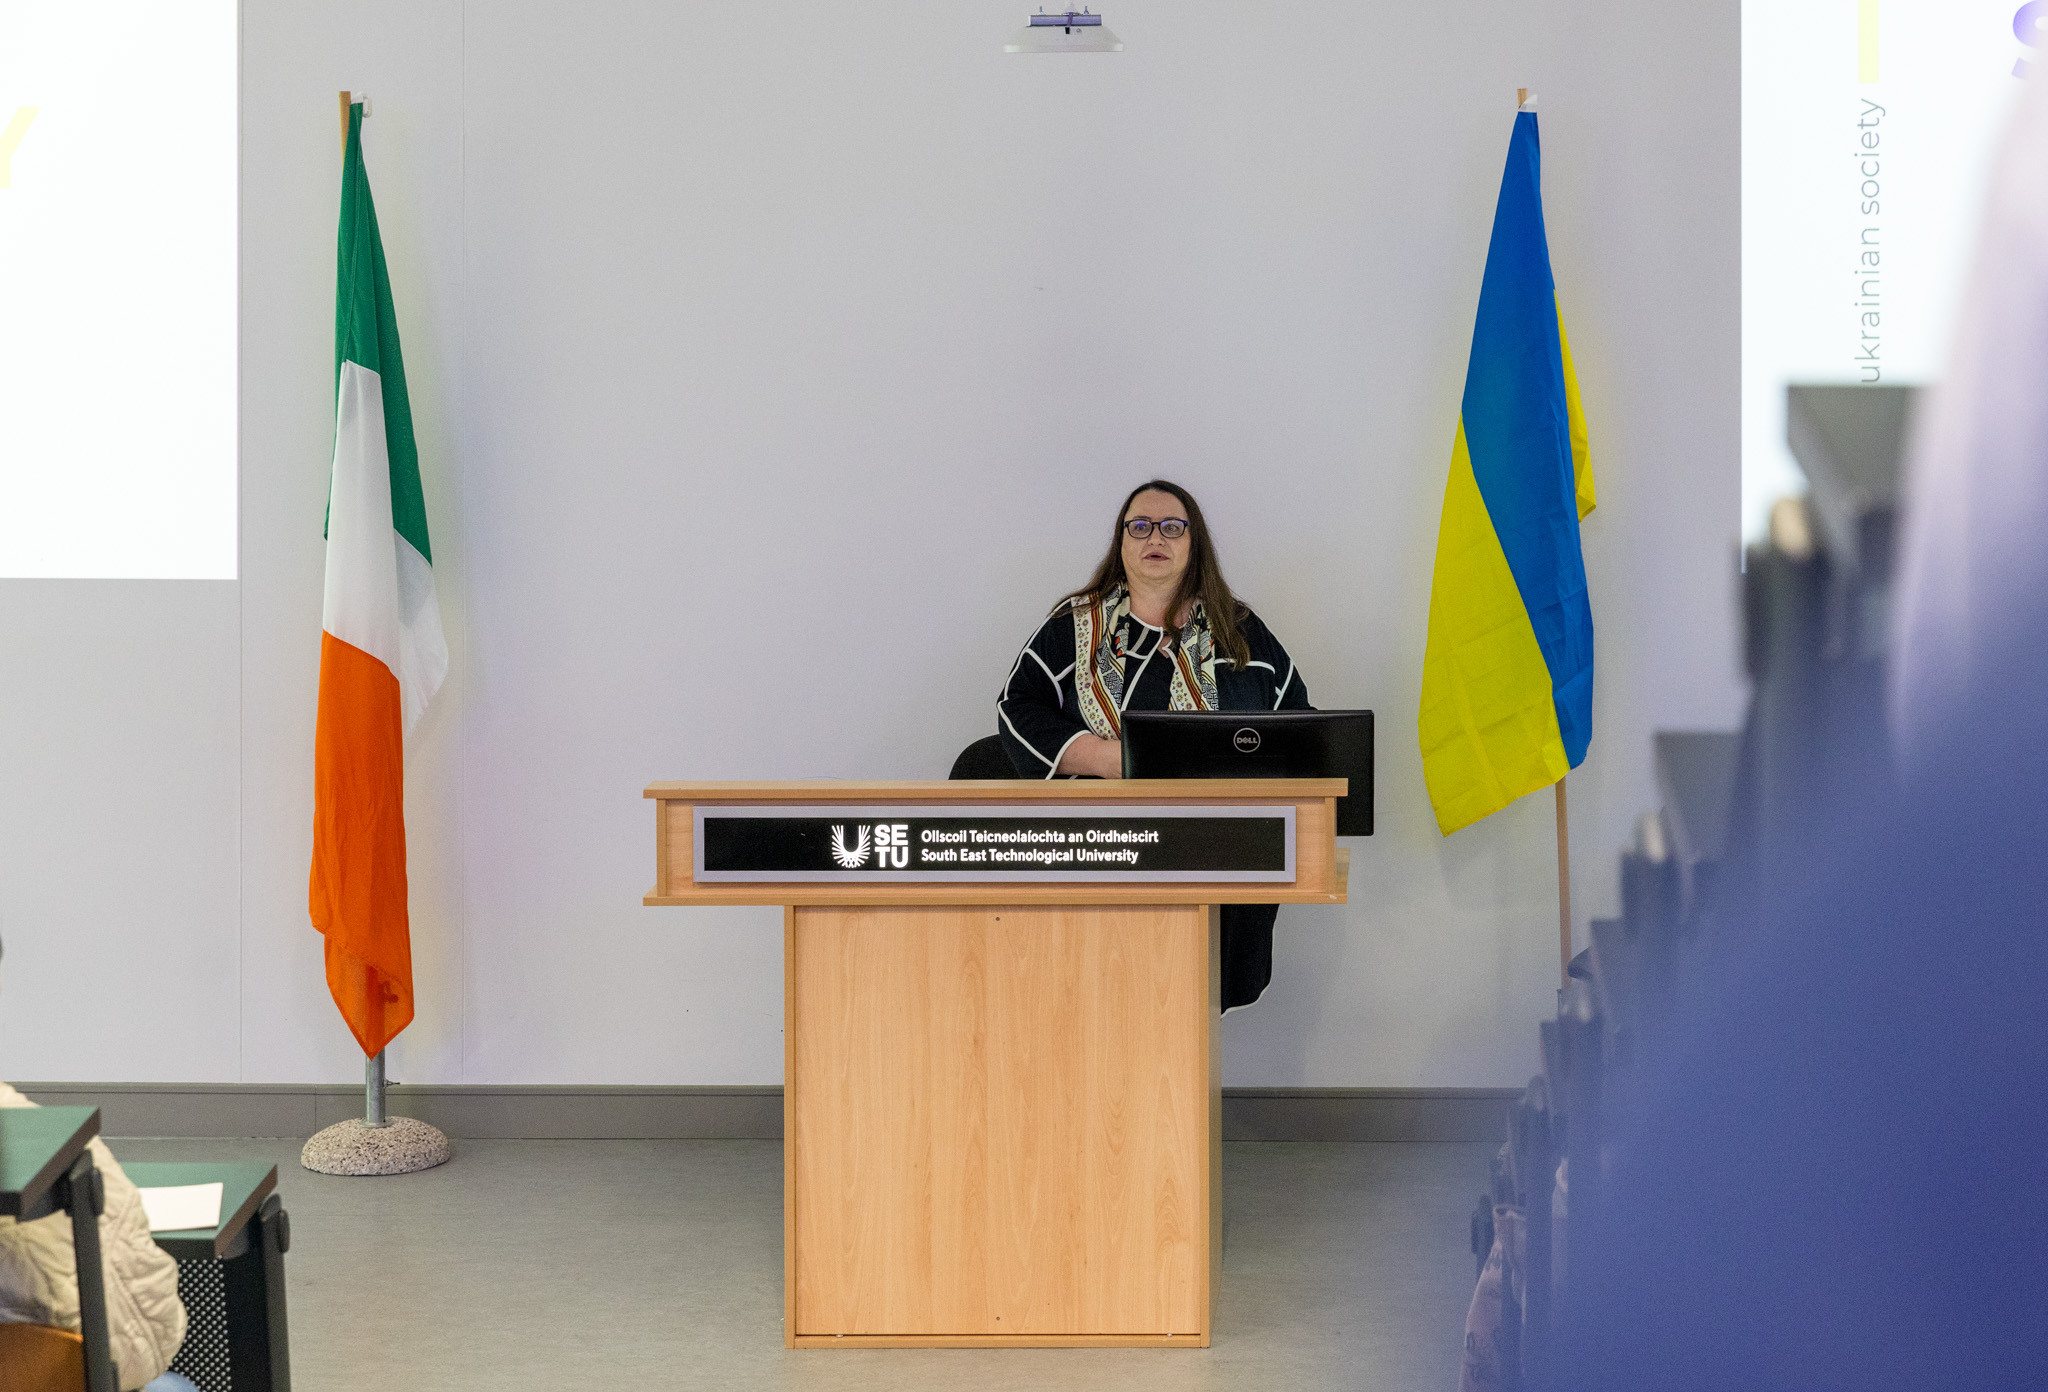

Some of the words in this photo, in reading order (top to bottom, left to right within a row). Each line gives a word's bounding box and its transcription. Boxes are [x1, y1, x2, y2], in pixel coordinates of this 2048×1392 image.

[1855, 98, 1885, 215] society
[1855, 228, 1880, 383] ukrainian
[874, 824, 909, 846] SE
[921, 830, 967, 843] Ollscoil
[1068, 833, 1084, 843] an
[1086, 830, 1160, 843] Oirdheiscirt
[874, 846, 909, 868] TU
[921, 849, 958, 862] South
[960, 849, 987, 862] East
[988, 849, 1074, 865] Technological
[1076, 849, 1139, 865] University
